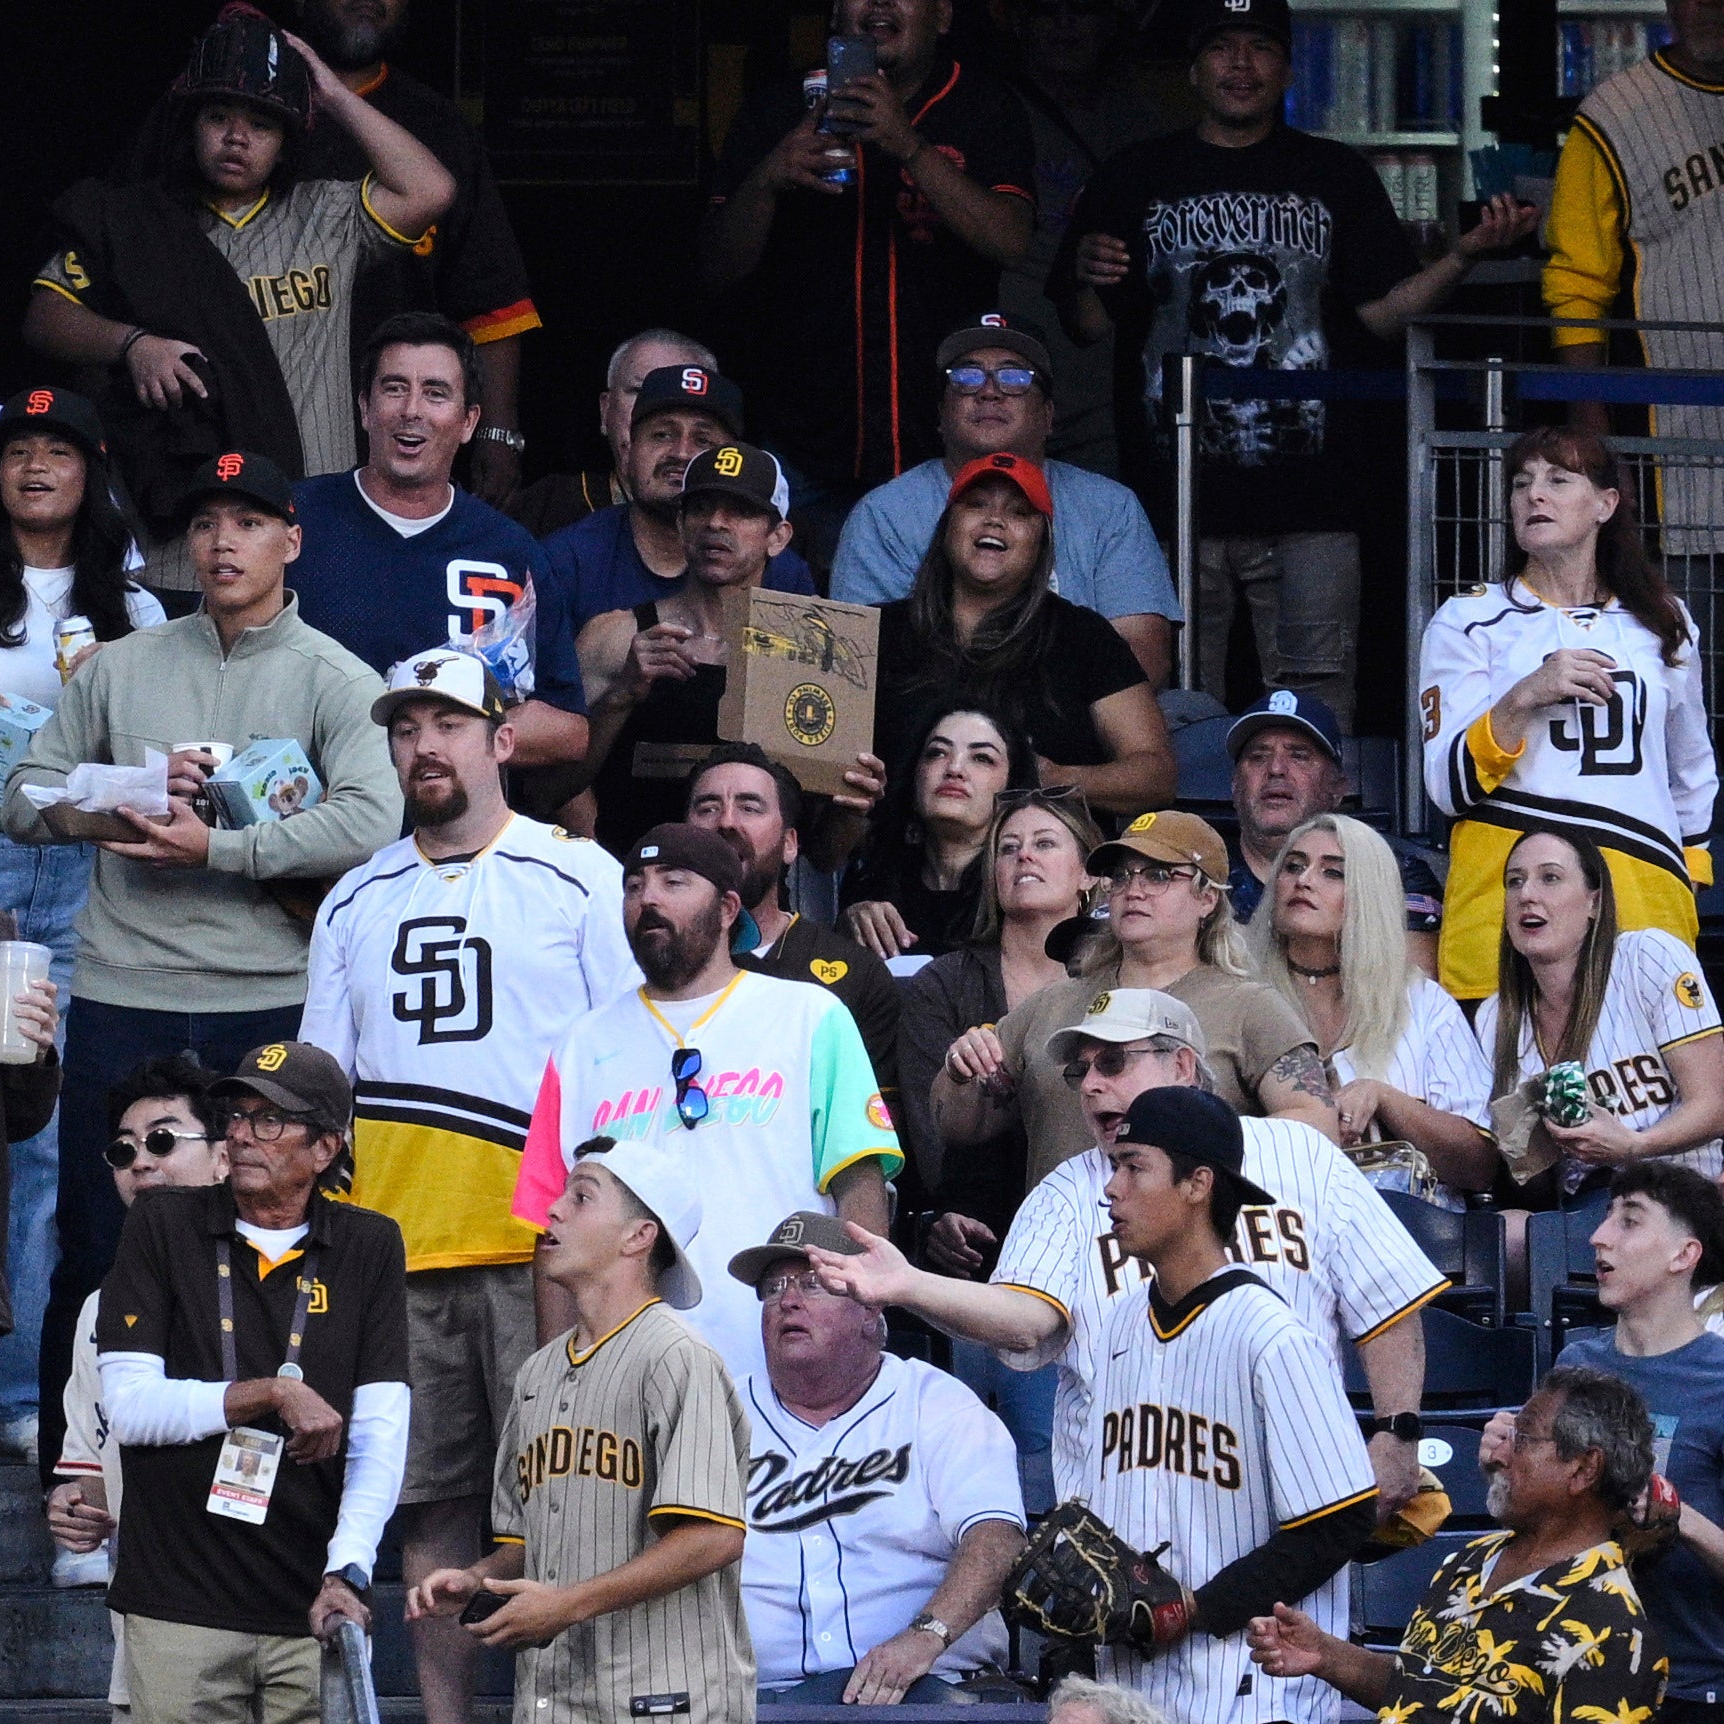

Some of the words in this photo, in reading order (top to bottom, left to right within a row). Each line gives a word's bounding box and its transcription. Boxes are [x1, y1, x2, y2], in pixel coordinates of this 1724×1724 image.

[267, 264, 331, 322] IEGO
[680, 367, 711, 396] SD
[216, 452, 245, 483] SF
[713, 446, 744, 478] SD
[389, 914, 494, 1047] SD
[820, 965, 839, 979] PS
[256, 1043, 288, 1072] SD
[1581, 1055, 1672, 1117] RES
[591, 1092, 660, 1140] SAN
[1096, 1205, 1311, 1298] PES
[546, 1426, 639, 1490] DIEGO
[1101, 1403, 1242, 1491] PADRES
[746, 1442, 912, 1535] Padres
